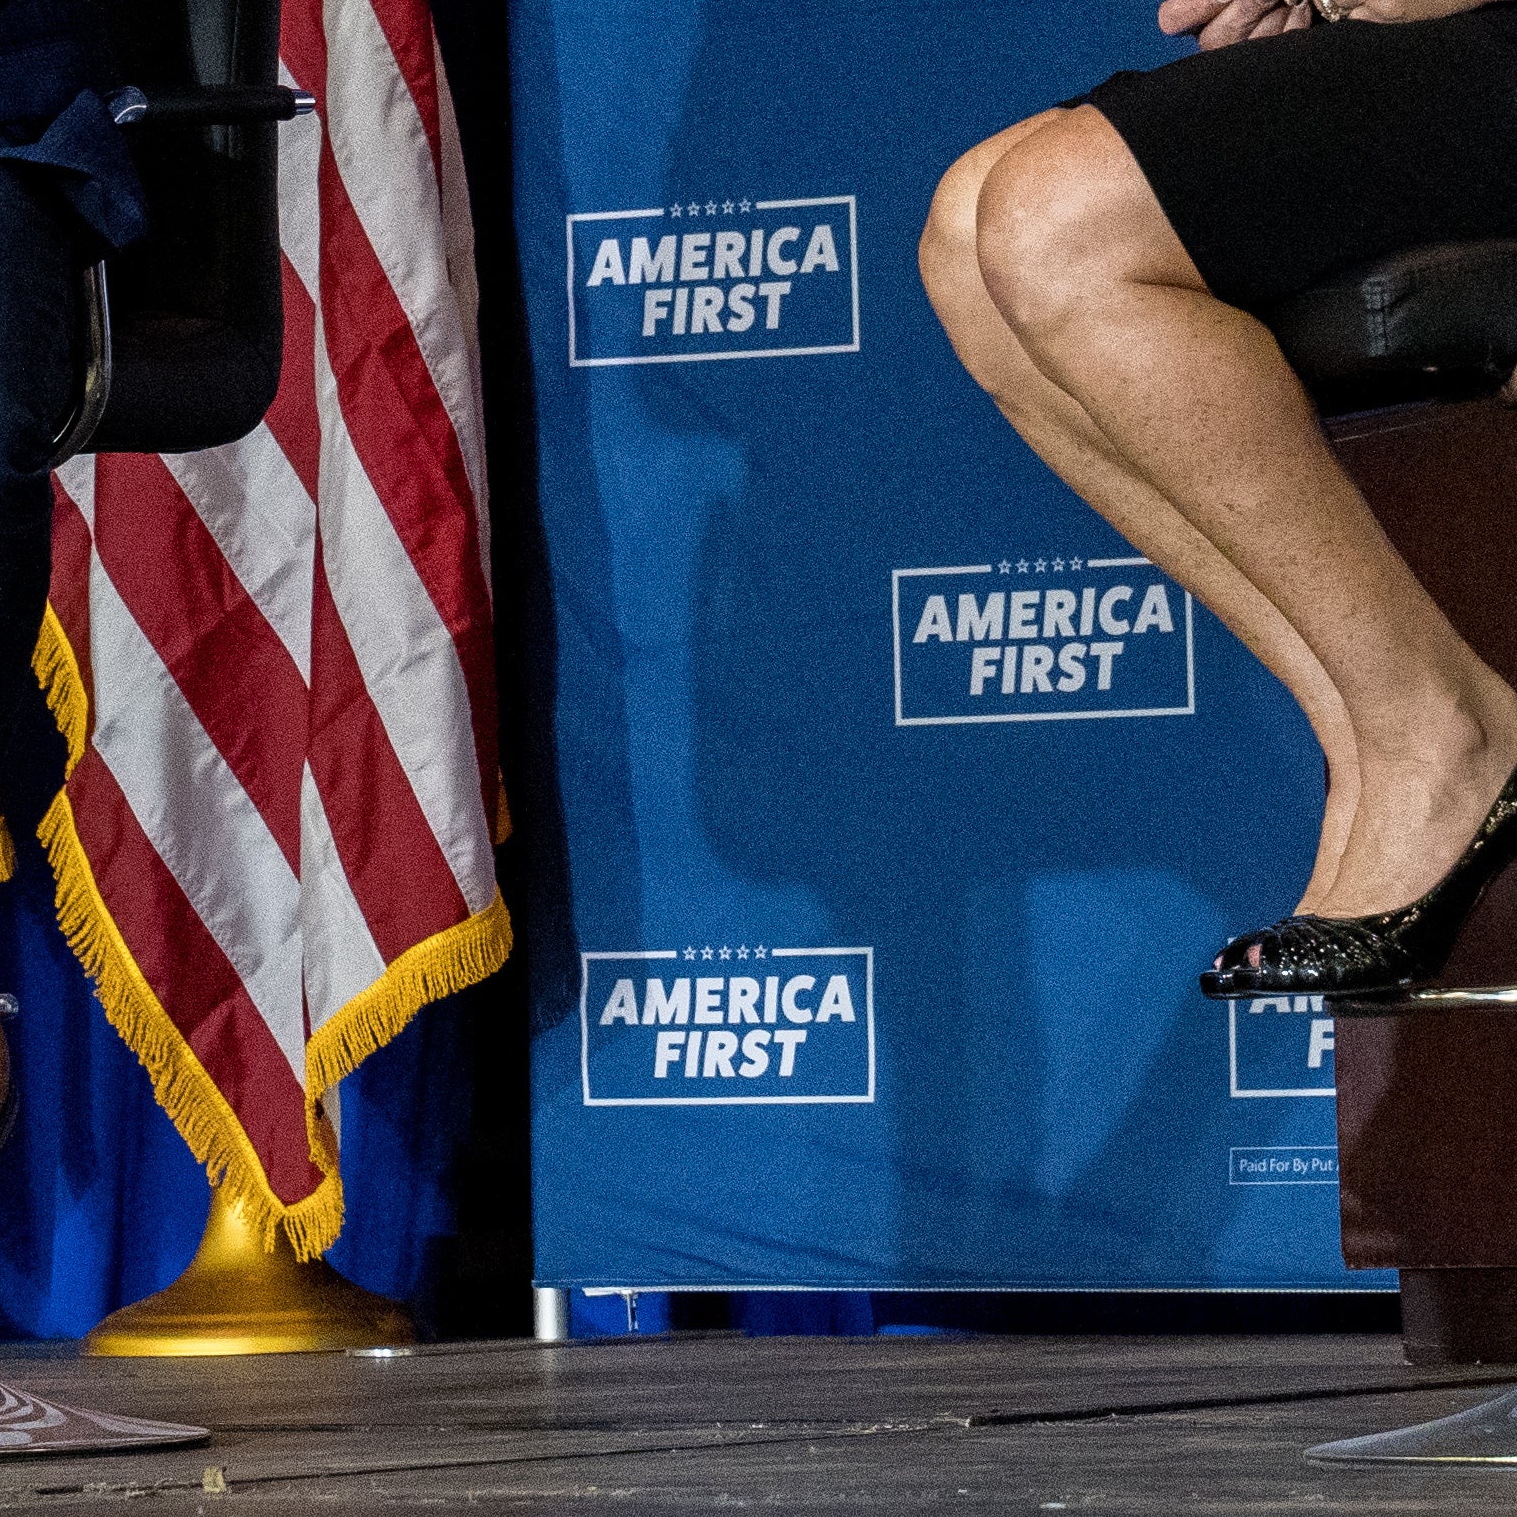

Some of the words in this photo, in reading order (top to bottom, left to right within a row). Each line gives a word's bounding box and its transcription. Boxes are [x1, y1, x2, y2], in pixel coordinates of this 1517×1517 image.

[586, 224, 839, 287] AMERICA
[642, 281, 792, 337] FIRST
[913, 584, 1174, 643] AMERICA
[969, 641, 1124, 696] FIRST
[600, 974, 856, 1025] AMERICA
[654, 1029, 807, 1078] FIRST
[1239, 1159, 1268, 1173] Paid
[1269, 1159, 1290, 1172] For
[1292, 1159, 1309, 1175] By
[1311, 1158, 1333, 1172] Put
